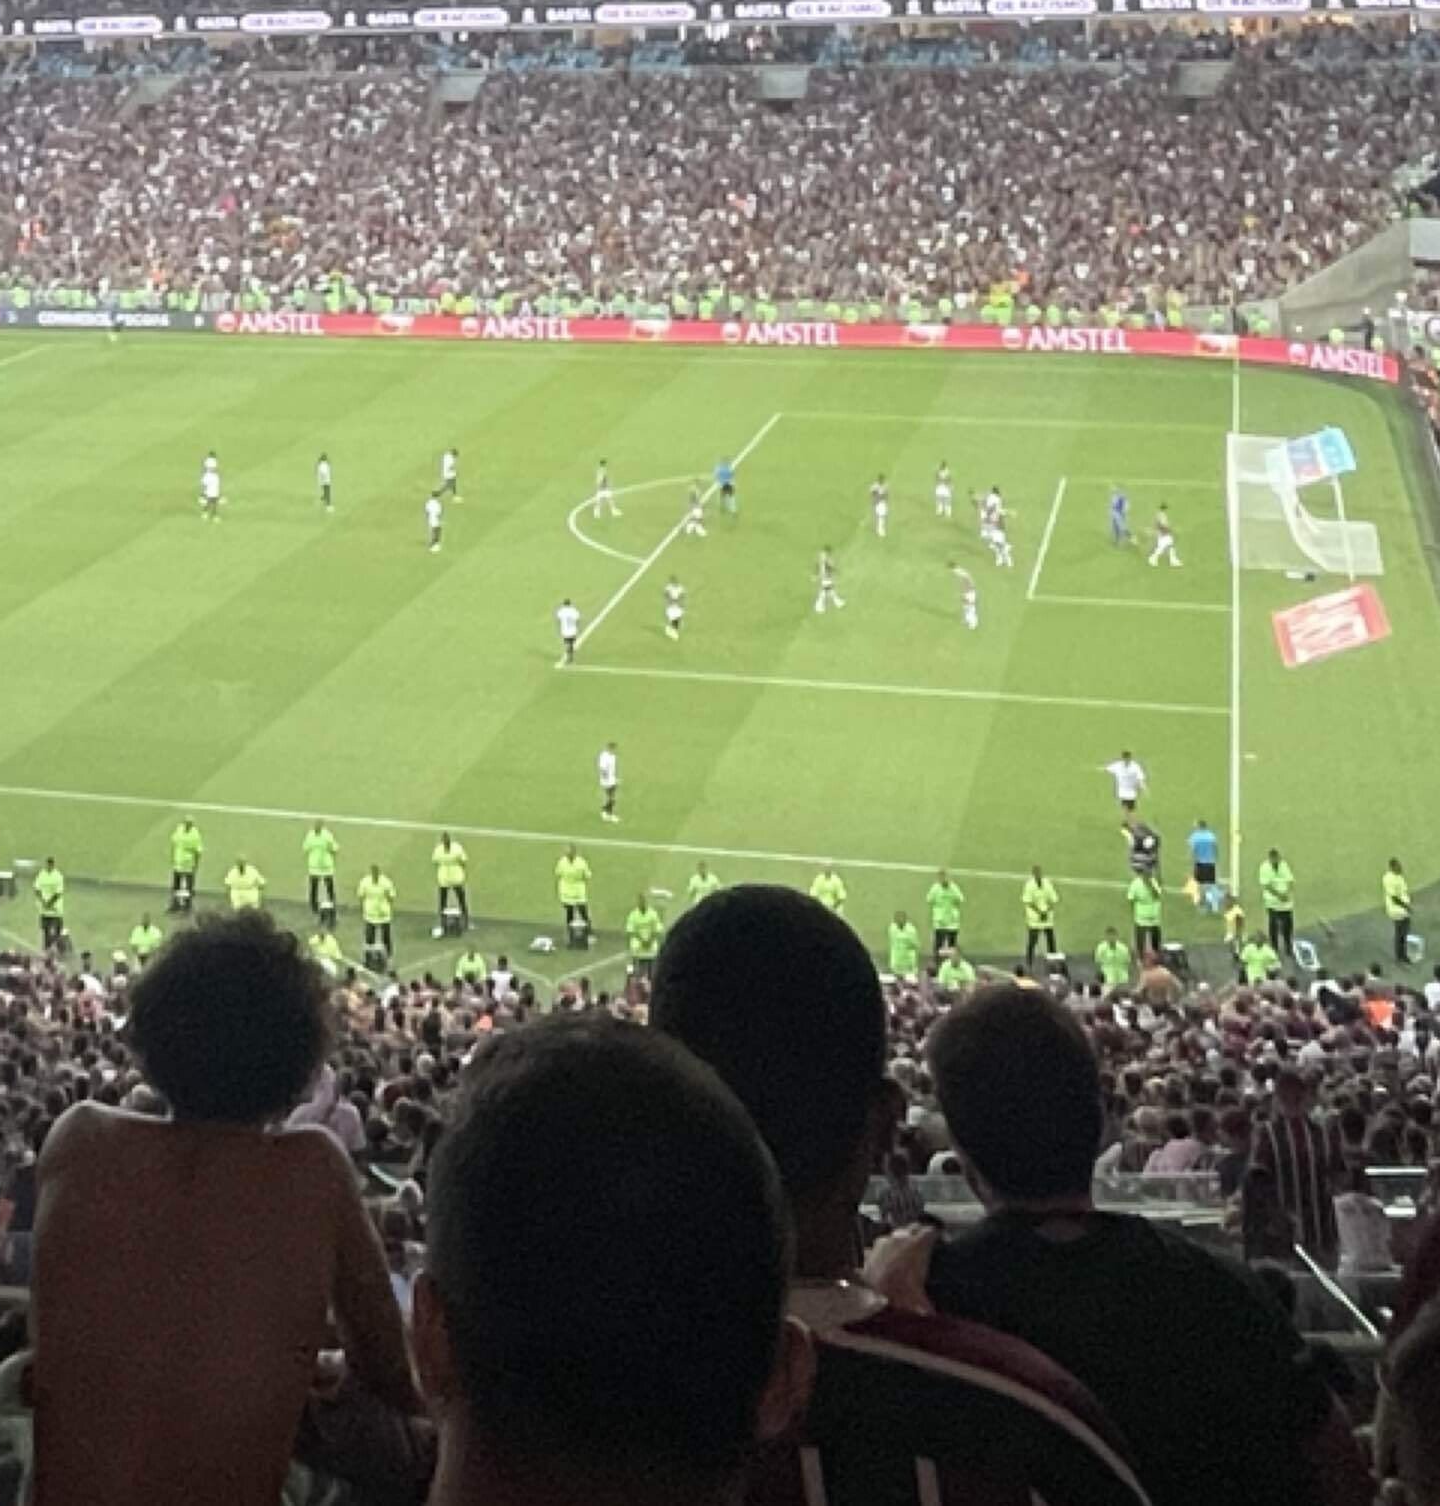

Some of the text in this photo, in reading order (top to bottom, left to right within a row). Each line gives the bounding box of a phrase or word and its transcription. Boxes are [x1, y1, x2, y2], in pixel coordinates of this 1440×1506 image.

[238, 312, 324, 335] AMSTEL
[479, 314, 573, 340] AMSTEL
[745, 322, 838, 346] AMSTEL
[1027, 327, 1131, 353] AMSTEL
[1310, 344, 1387, 381] AMSTEL
